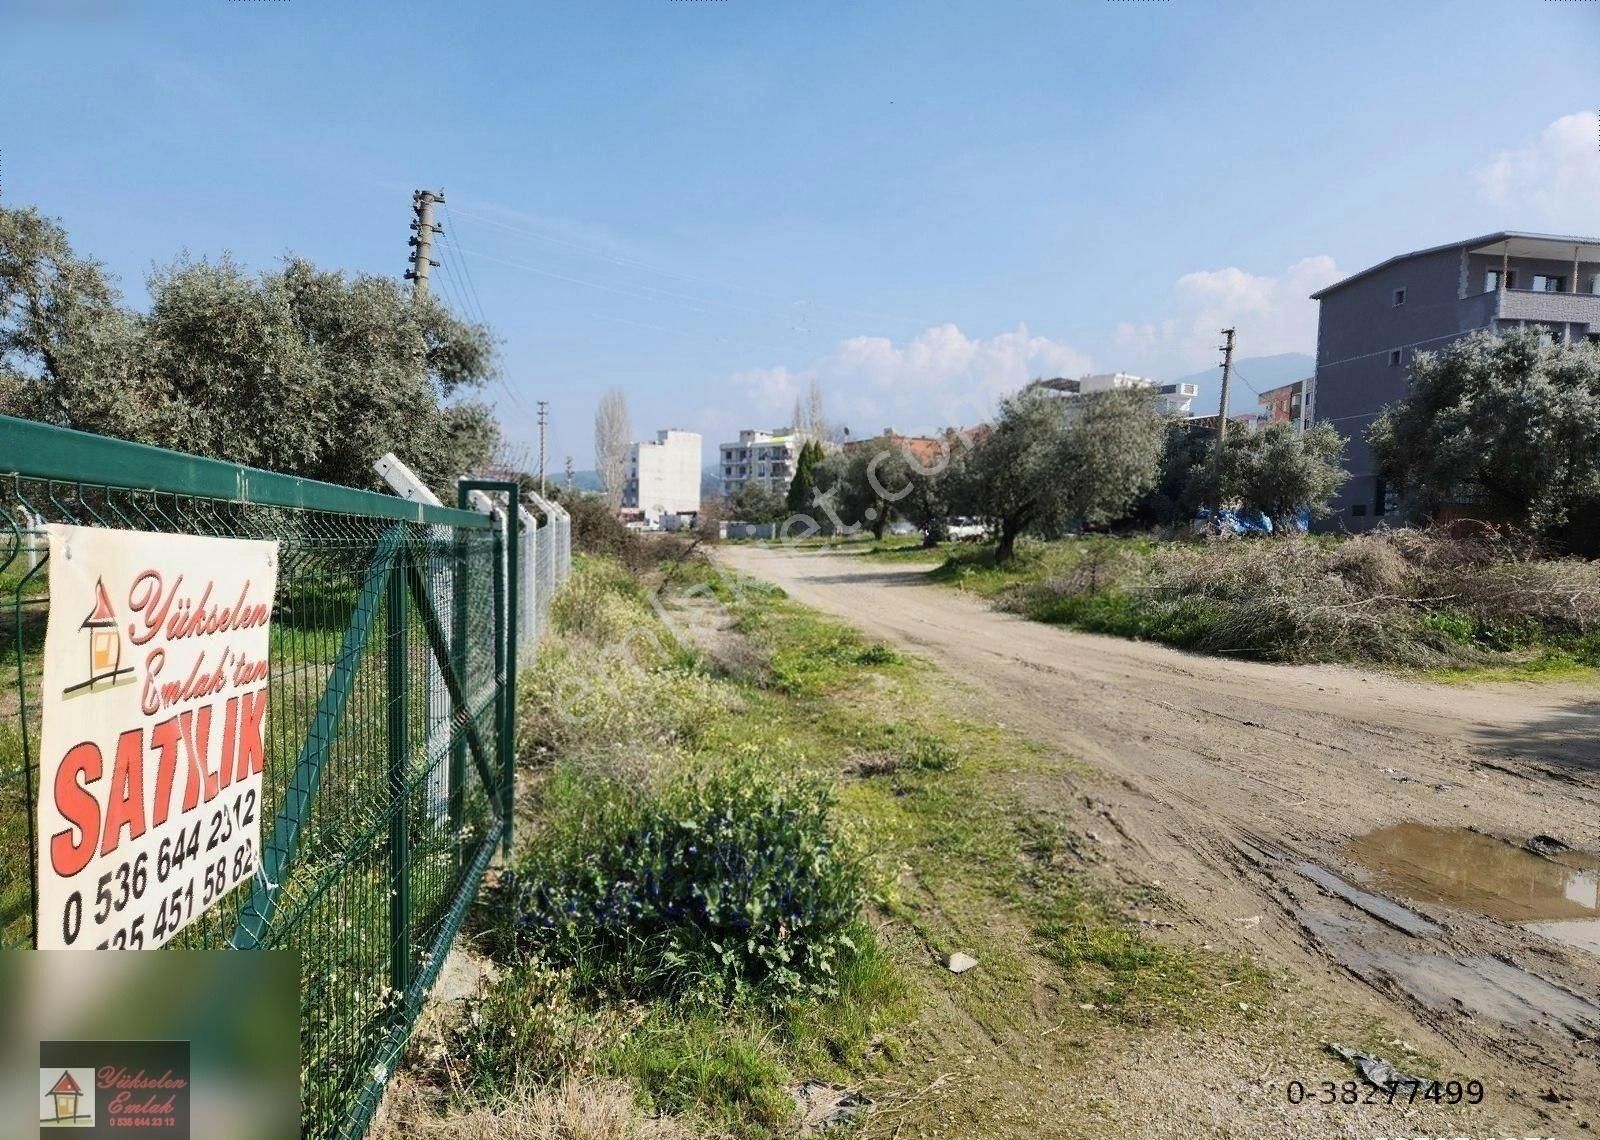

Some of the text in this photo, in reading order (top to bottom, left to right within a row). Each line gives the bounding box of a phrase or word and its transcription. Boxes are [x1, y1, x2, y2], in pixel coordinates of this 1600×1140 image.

[128, 569, 270, 645] Yükselen
[141, 646, 268, 716] Emlak'tan
[50, 688, 268, 878] SATILIK
[63, 890, 82, 945] 0
[94, 851, 149, 925] 536
[157, 820, 202, 884] 644
[152, 876, 194, 941] 451
[203, 855, 227, 906] 58
[232, 837, 253, 883] 82
